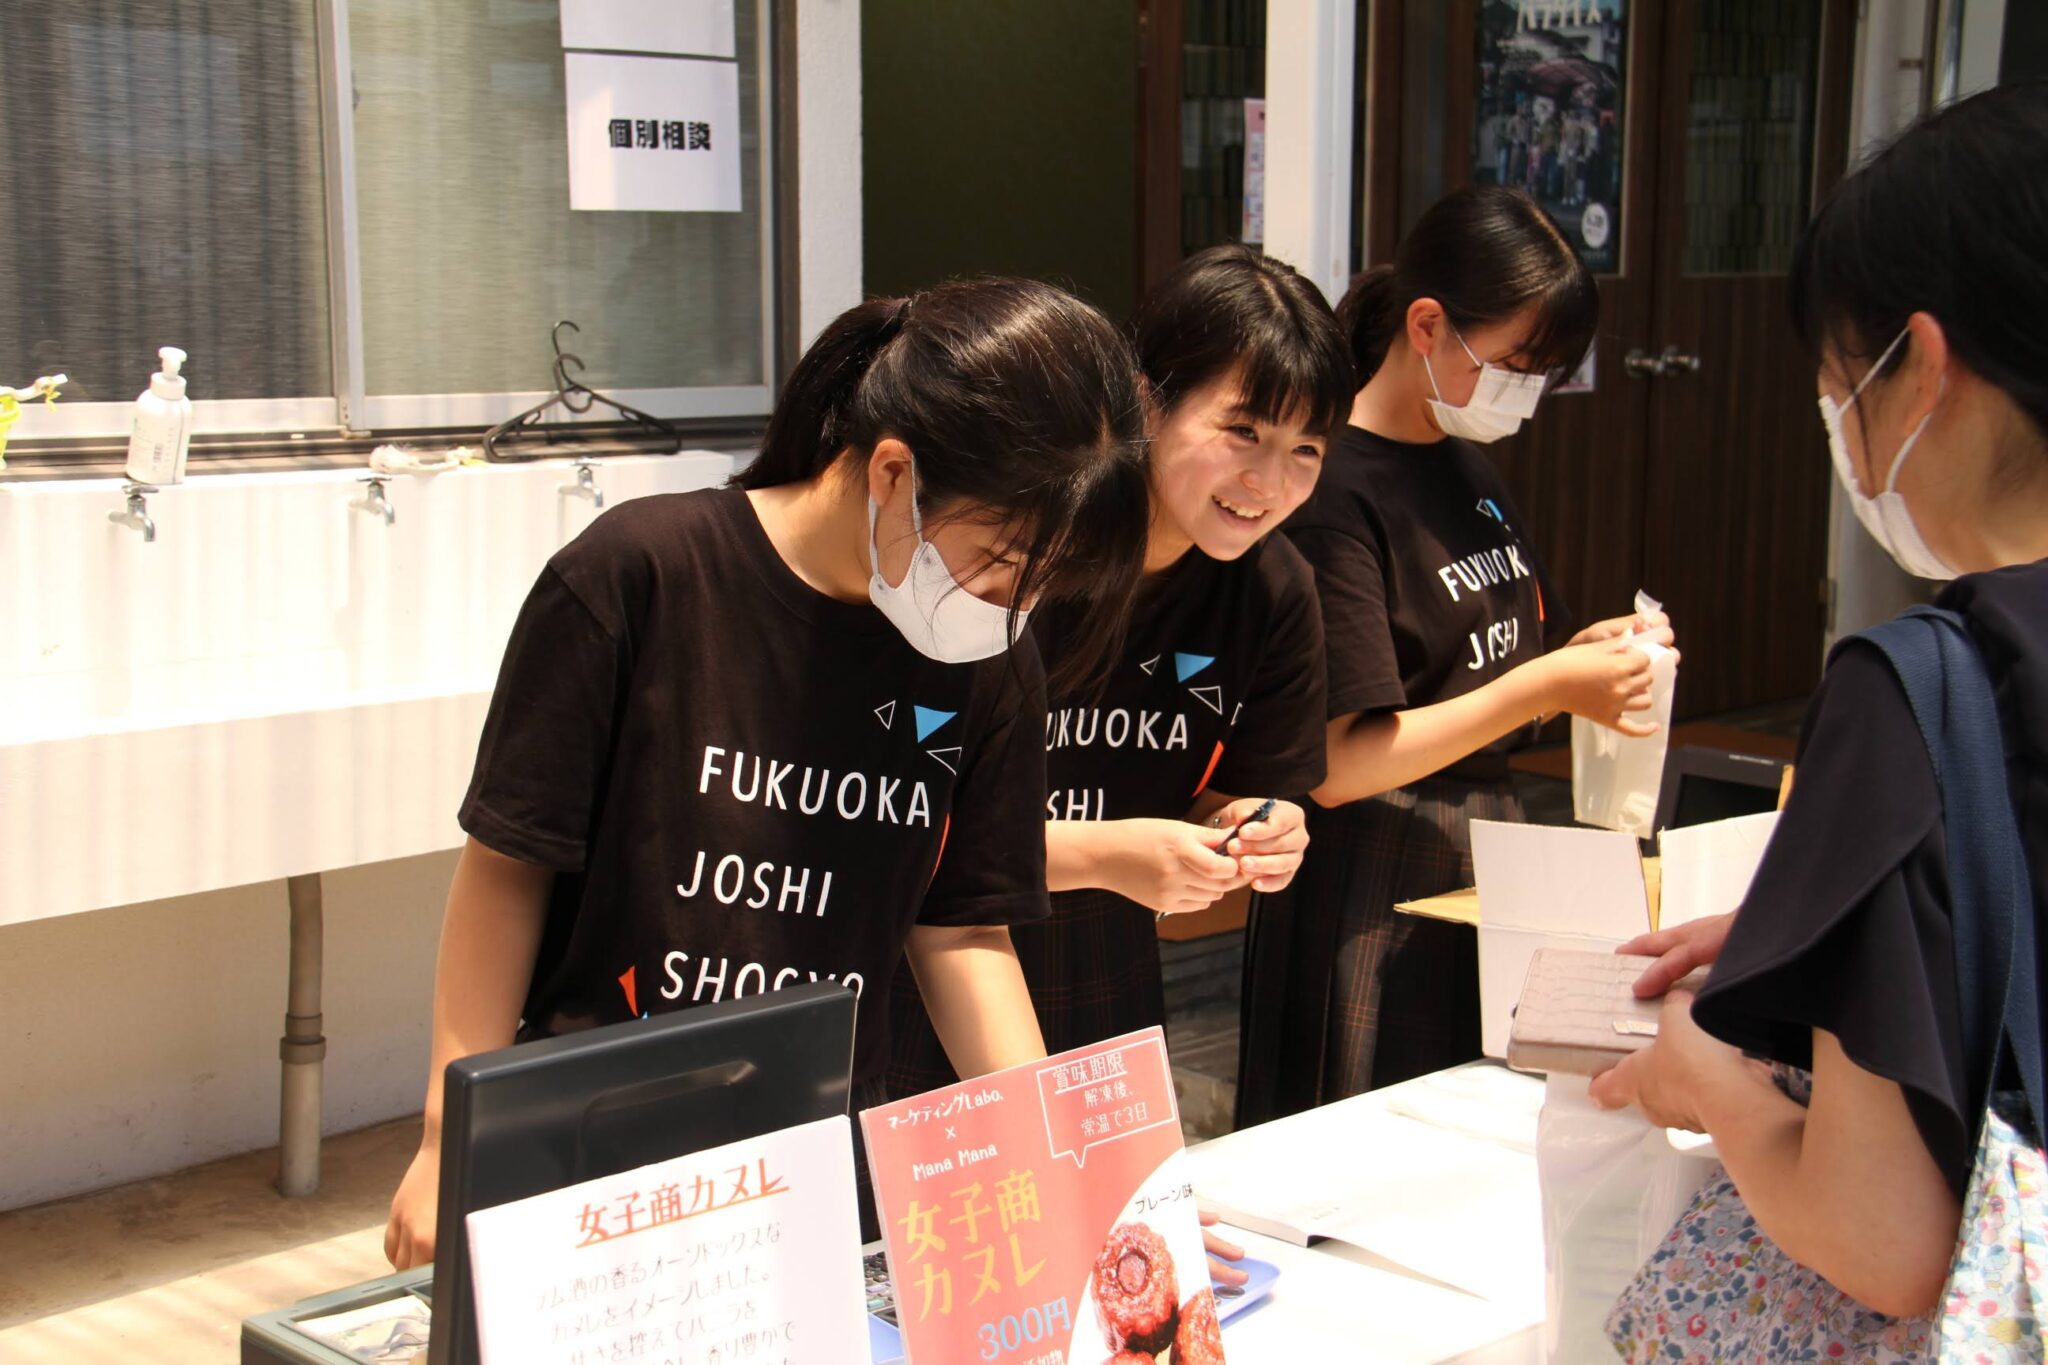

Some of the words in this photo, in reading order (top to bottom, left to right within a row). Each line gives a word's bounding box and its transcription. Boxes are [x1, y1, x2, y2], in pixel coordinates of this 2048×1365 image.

[608, 119, 711, 151] 個別相談
[1438, 544, 1530, 602] FUKUOK
[1046, 707, 1188, 751] UKUOKA
[699, 745, 930, 828] FUKUOKA
[1046, 788, 1104, 821] SHI
[676, 851, 833, 917] JOSHI
[660, 950, 864, 1003] SHO
[1053, 1051, 1126, 1091] 賞味期限
[1081, 1101, 1148, 1137] 常温で3日
[912, 1157, 954, 1182] Mana
[957, 1143, 999, 1168] Mana
[576, 1157, 785, 1241] 女子商カヌレ
[897, 1168, 1041, 1264] 女子商
[913, 1232, 1048, 1323] カヌレ
[978, 1296, 1070, 1361] 300円
